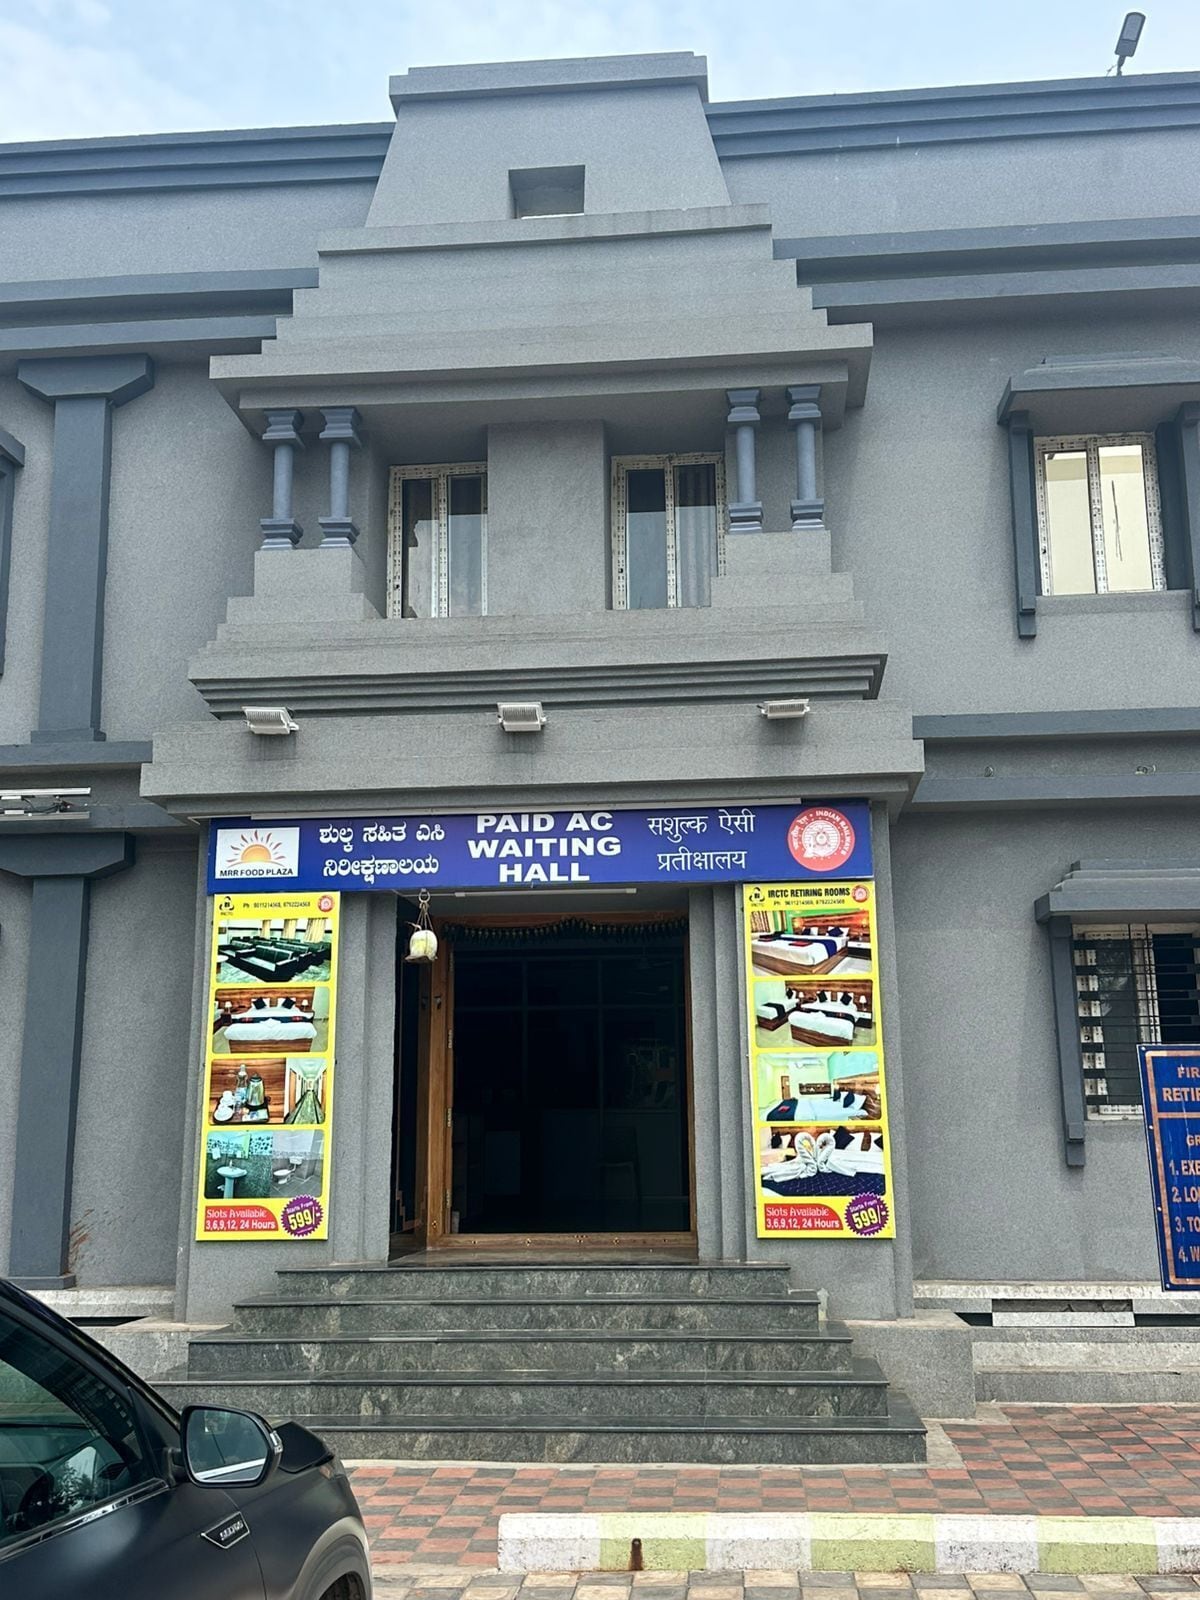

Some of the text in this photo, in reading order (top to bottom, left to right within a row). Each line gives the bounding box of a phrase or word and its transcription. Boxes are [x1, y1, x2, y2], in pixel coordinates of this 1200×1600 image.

[476, 812, 613, 834] PAID AC
[815, 810, 841, 822] INDIAN
[647, 808, 756, 843] सशुल्क ऐसी
[319, 821, 445, 852] ಶುಲ್ಕ ಸಹಿತ ಎಸಿ
[467, 836, 622, 859] WAITING
[656, 846, 748, 872] प्रतीक्षालय
[219, 868, 294, 877] MRR FOOD PLAZA
[323, 853, 439, 884] ನಿರೀಕ್ಷಣಾಲಯ
[499, 862, 591, 883] HALL
[767, 889, 789, 898] IRCTC
[790, 888, 823, 897] RETIRING
[824, 887, 850, 897] ROOMS
[1172, 1186, 1182, 1203] 2.
[206, 1208, 267, 1218] Slots Available
[766, 1207, 829, 1217] Slots Available
[240, 1219, 250, 1229] 24
[251, 1219, 276, 1230] Hours
[802, 1218, 812, 1228] 24
[814, 1218, 840, 1229] Hours
[1175, 1216, 1185, 1233] 3.
